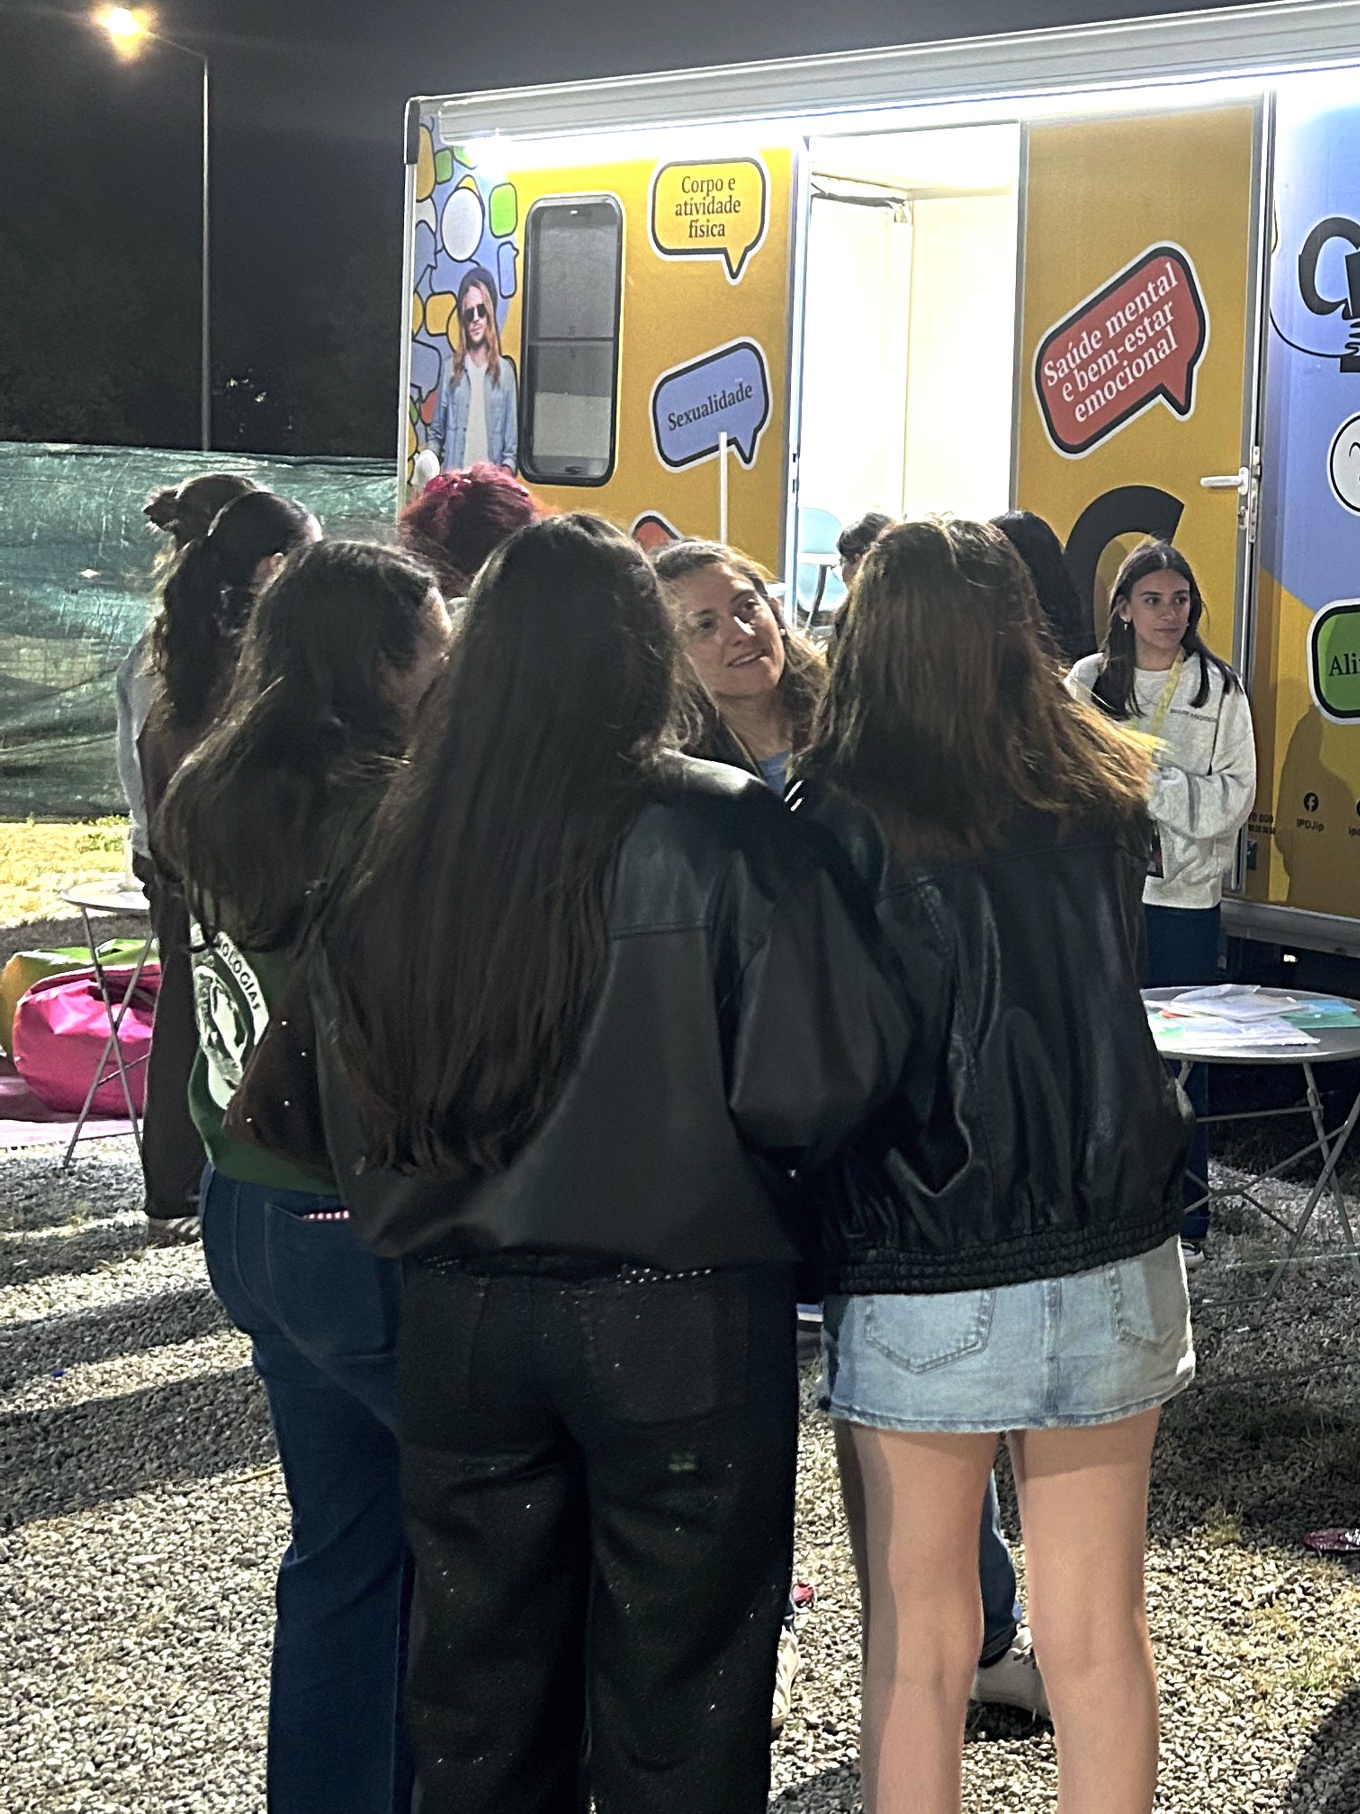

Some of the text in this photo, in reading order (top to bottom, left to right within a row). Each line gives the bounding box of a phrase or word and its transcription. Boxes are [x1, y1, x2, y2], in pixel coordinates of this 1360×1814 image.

[675, 194, 741, 217] atividade
[681, 175, 736, 197] Corpo e
[688, 218, 726, 239] física
[1043, 261, 1179, 387] Saúde mental
[1062, 301, 1175, 403] e bem-estar
[1074, 325, 1179, 423] emocional
[667, 382, 753, 431] Sexualidade
